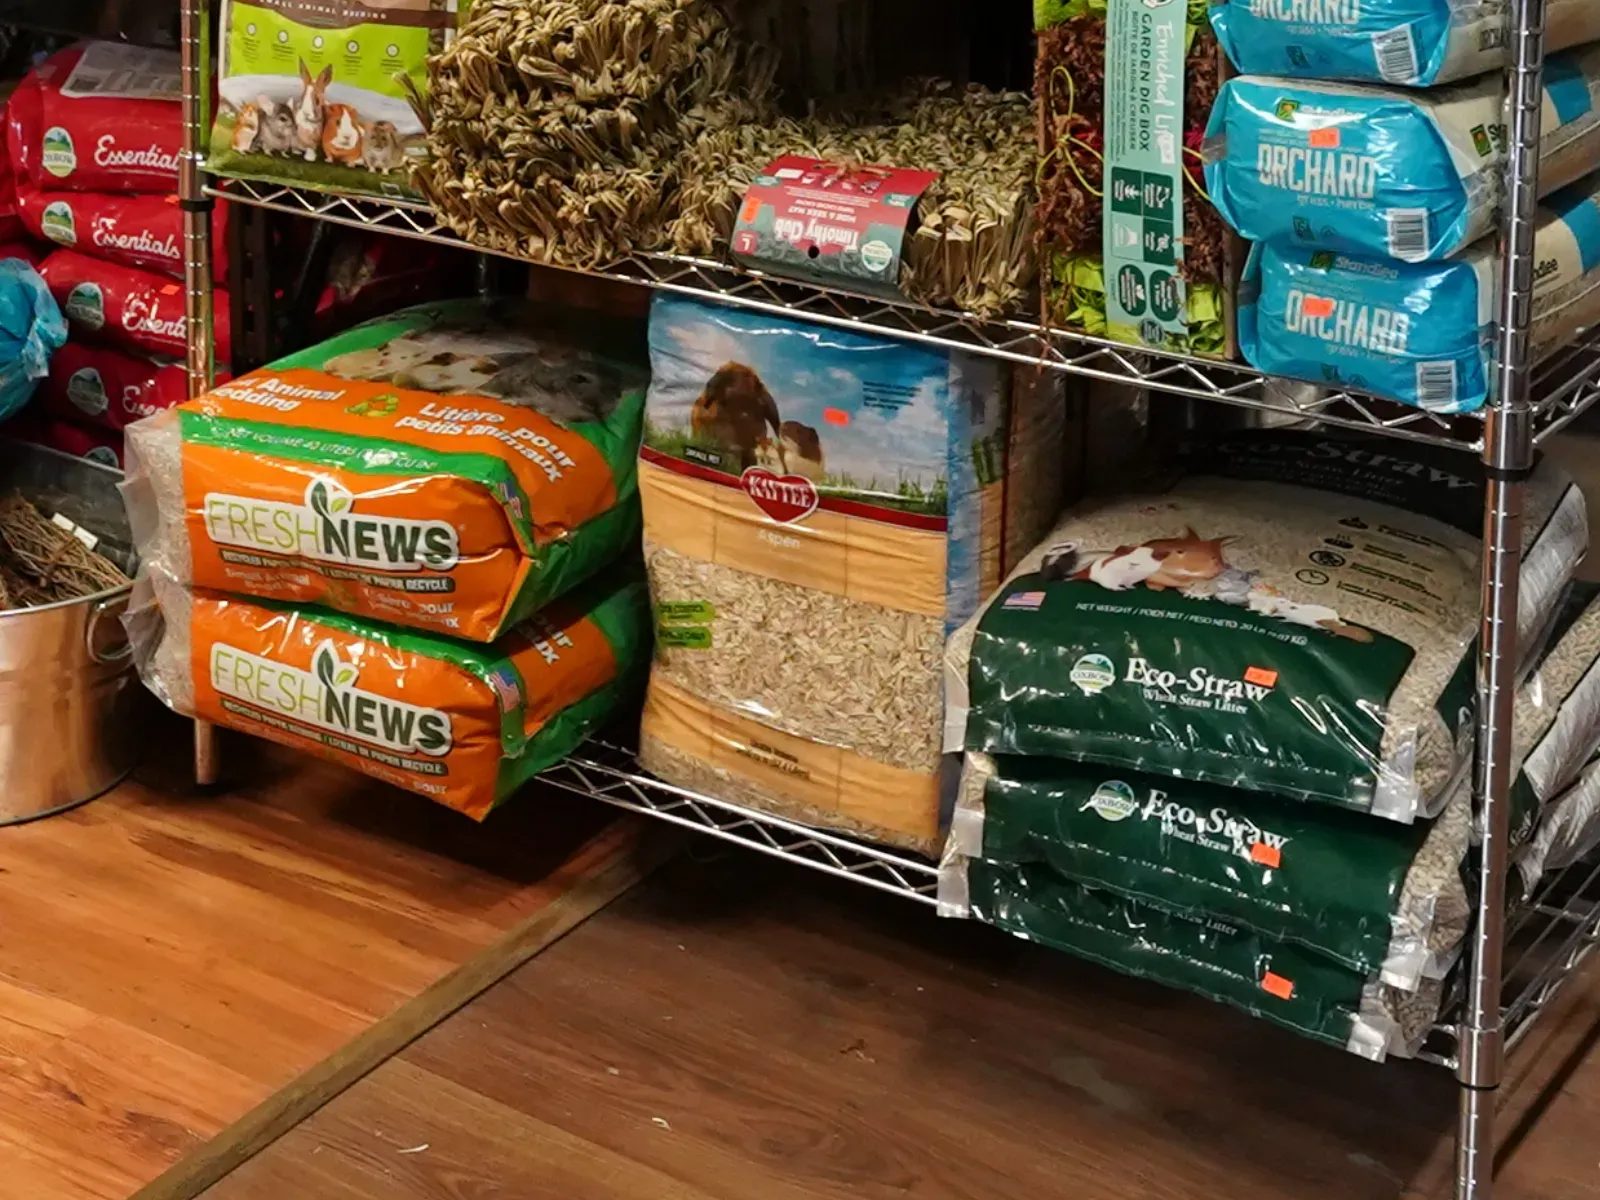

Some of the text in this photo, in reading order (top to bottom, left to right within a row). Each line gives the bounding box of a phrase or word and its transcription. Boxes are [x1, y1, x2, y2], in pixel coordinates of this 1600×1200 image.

[1139, 13, 1152, 151] GARDEN DIG BOX
[1154, 21, 1176, 107] Enriched
[94, 134, 180, 171] Essential
[1257, 143, 1377, 199] ORCHARD
[92, 217, 182, 259] Essentials
[774, 214, 860, 253] Timothy Club
[1335, 256, 1399, 279] Standlee
[1285, 289, 1409, 353] ORCHARD
[210, 386, 302, 411] edding
[255, 377, 346, 401] Animal
[394, 415, 564, 482] petits animaux
[511, 426, 577, 469] pour
[750, 475, 811, 508] KAYTEE
[1075, 602, 1095, 612] NET
[1096, 604, 1133, 615] WEIGHT
[1167, 610, 1184, 621] NET
[1123, 656, 1274, 701] Eco-Straw
[1142, 687, 1249, 714] Wheat Straw Litter
[1148, 788, 1291, 851] EcoStraw
[1196, 832, 1230, 853] Straw
[1205, 918, 1239, 936] Litter
